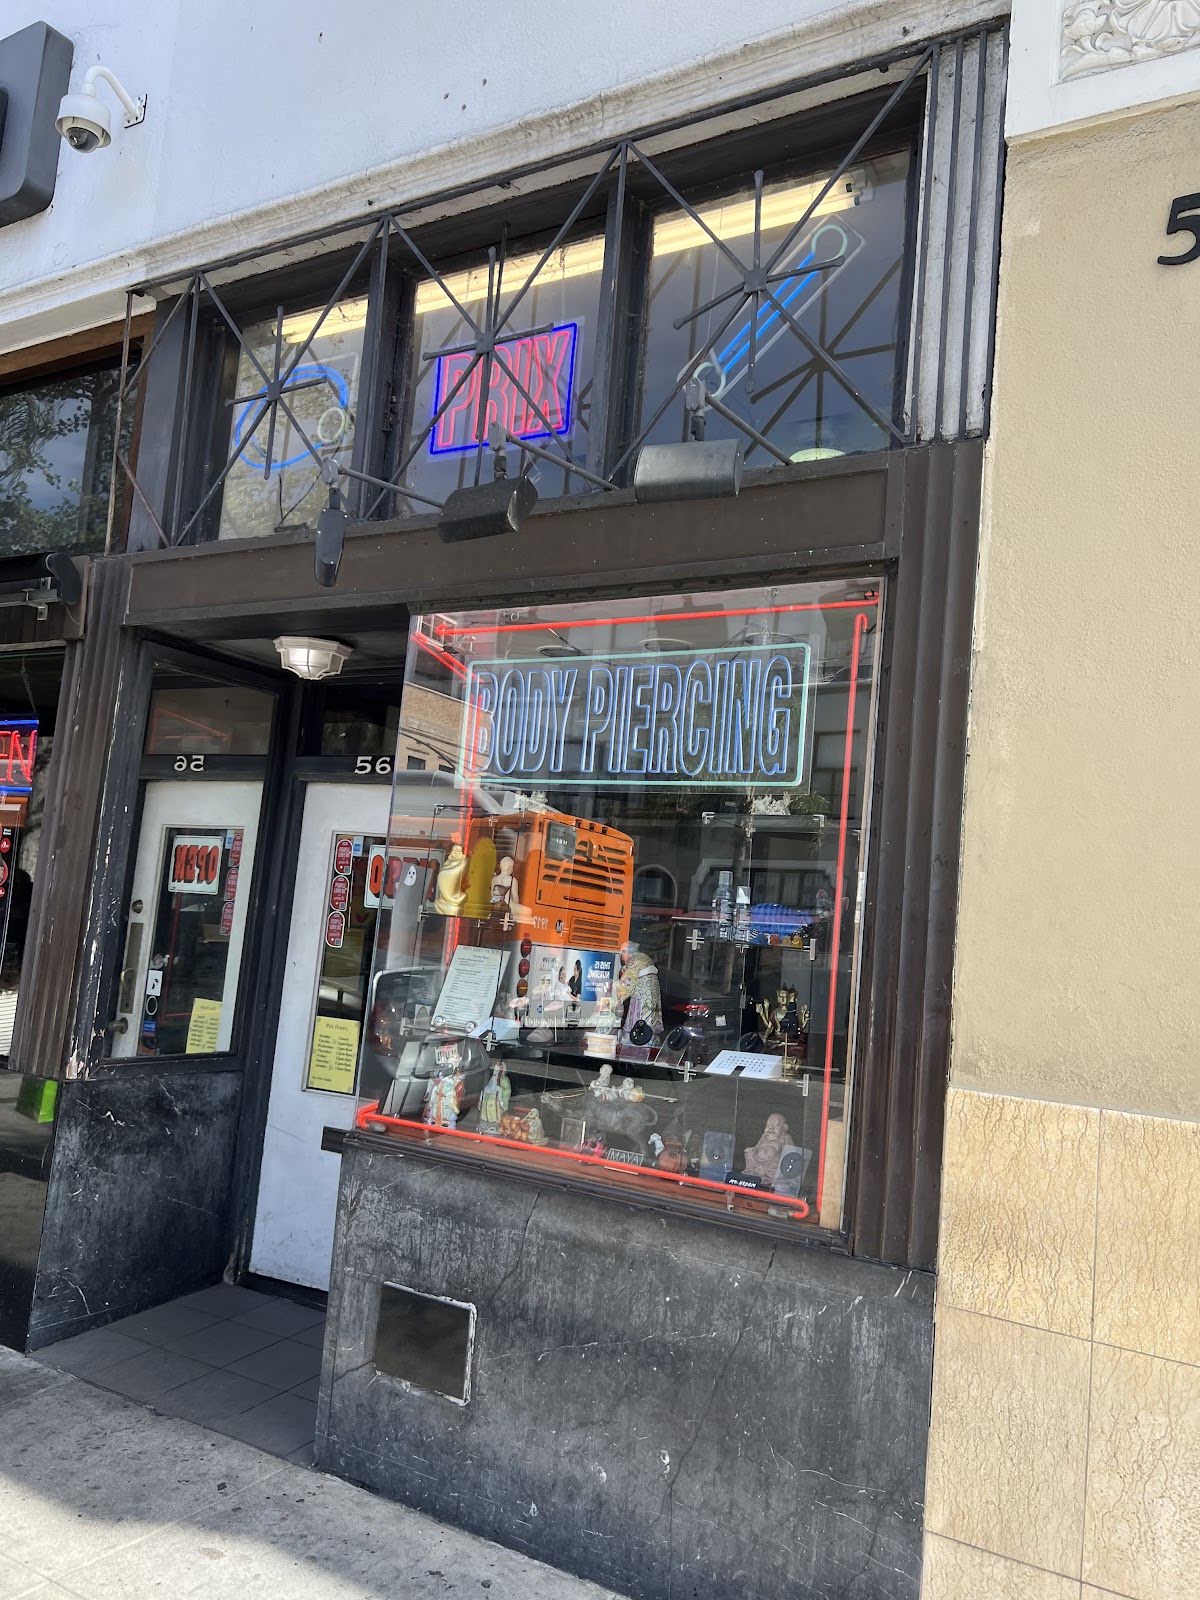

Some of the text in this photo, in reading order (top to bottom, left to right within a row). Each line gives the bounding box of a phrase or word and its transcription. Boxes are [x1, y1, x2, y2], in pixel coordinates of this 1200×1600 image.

[1157, 192, 1200, 265] 5
[438, 331, 571, 447] PRIX
[468, 655, 792, 776] BODY PIERCING
[354, 756, 391, 774] 56
[610, 1150, 639, 1166] MAYA
